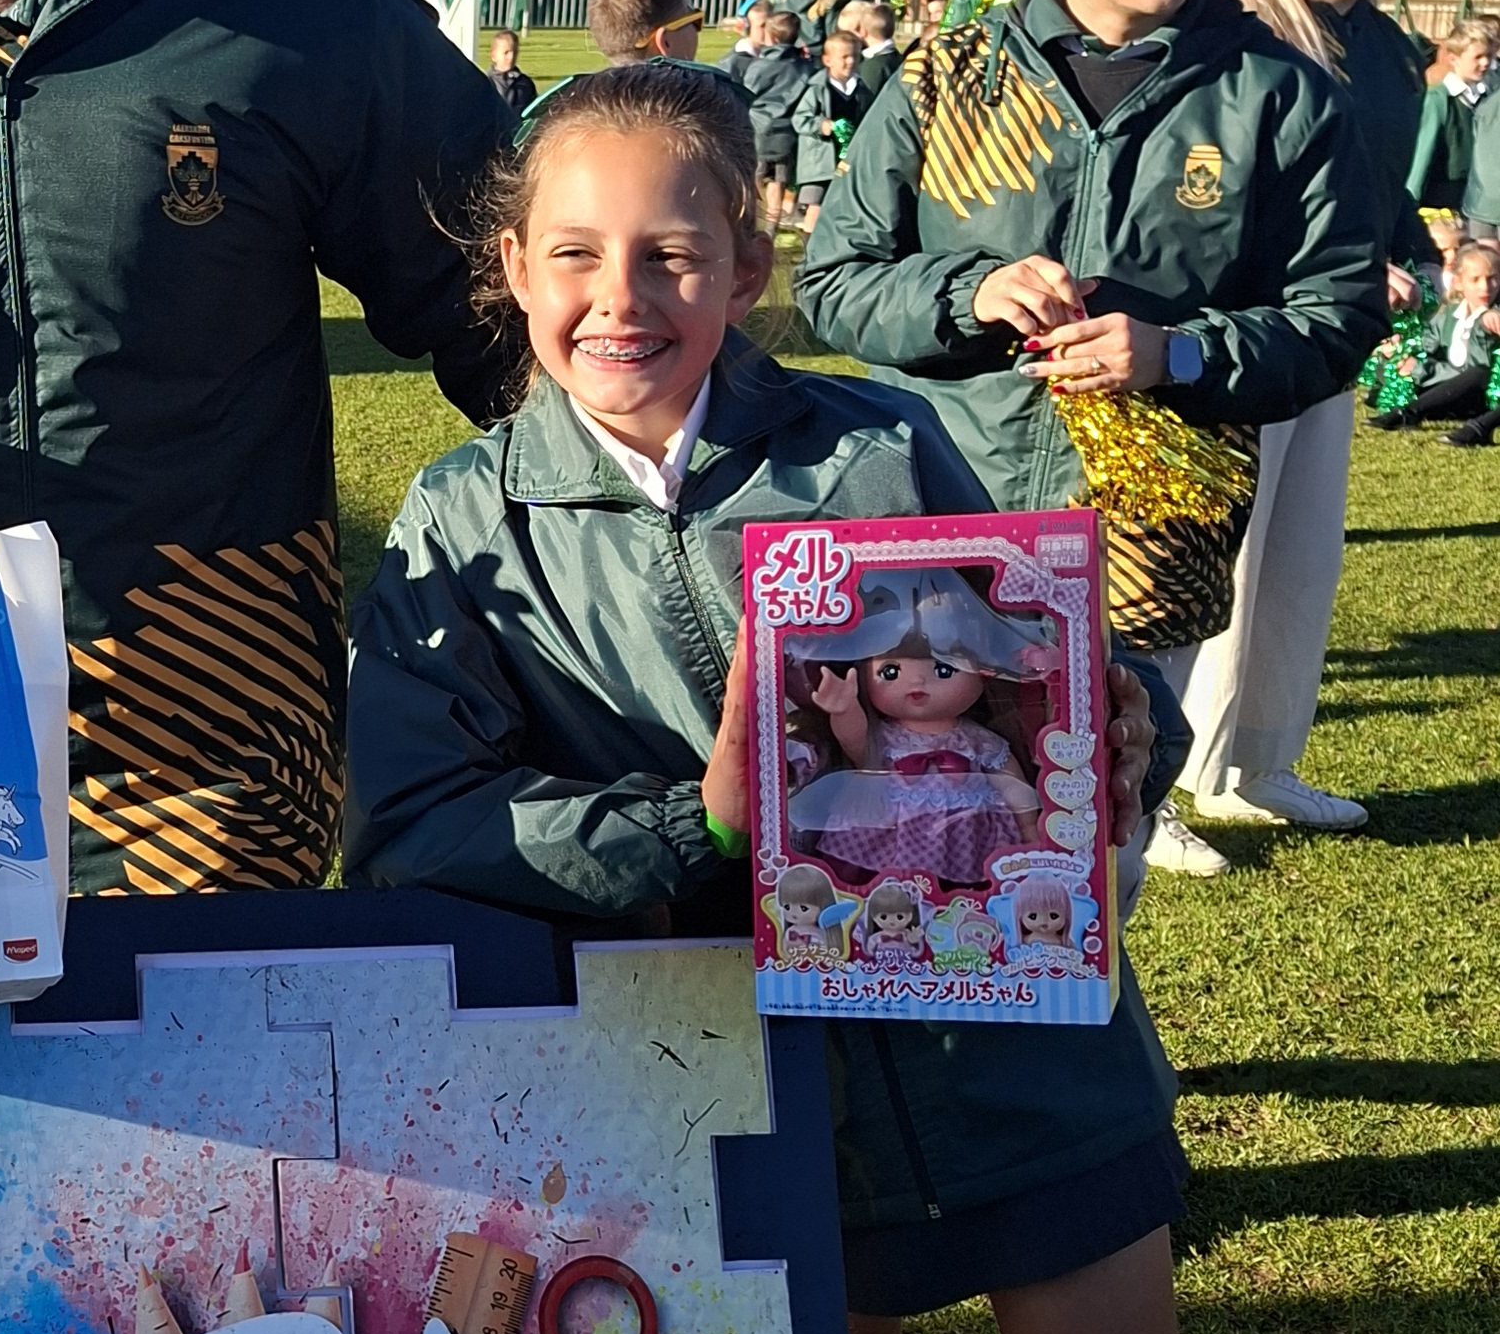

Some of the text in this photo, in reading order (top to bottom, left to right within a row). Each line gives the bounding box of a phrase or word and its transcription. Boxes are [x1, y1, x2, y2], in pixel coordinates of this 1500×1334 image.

[759, 536, 845, 585] メル
[759, 585, 846, 620] ちゃん
[821, 976, 1034, 1003] おしゃれヘアメルちゃん
